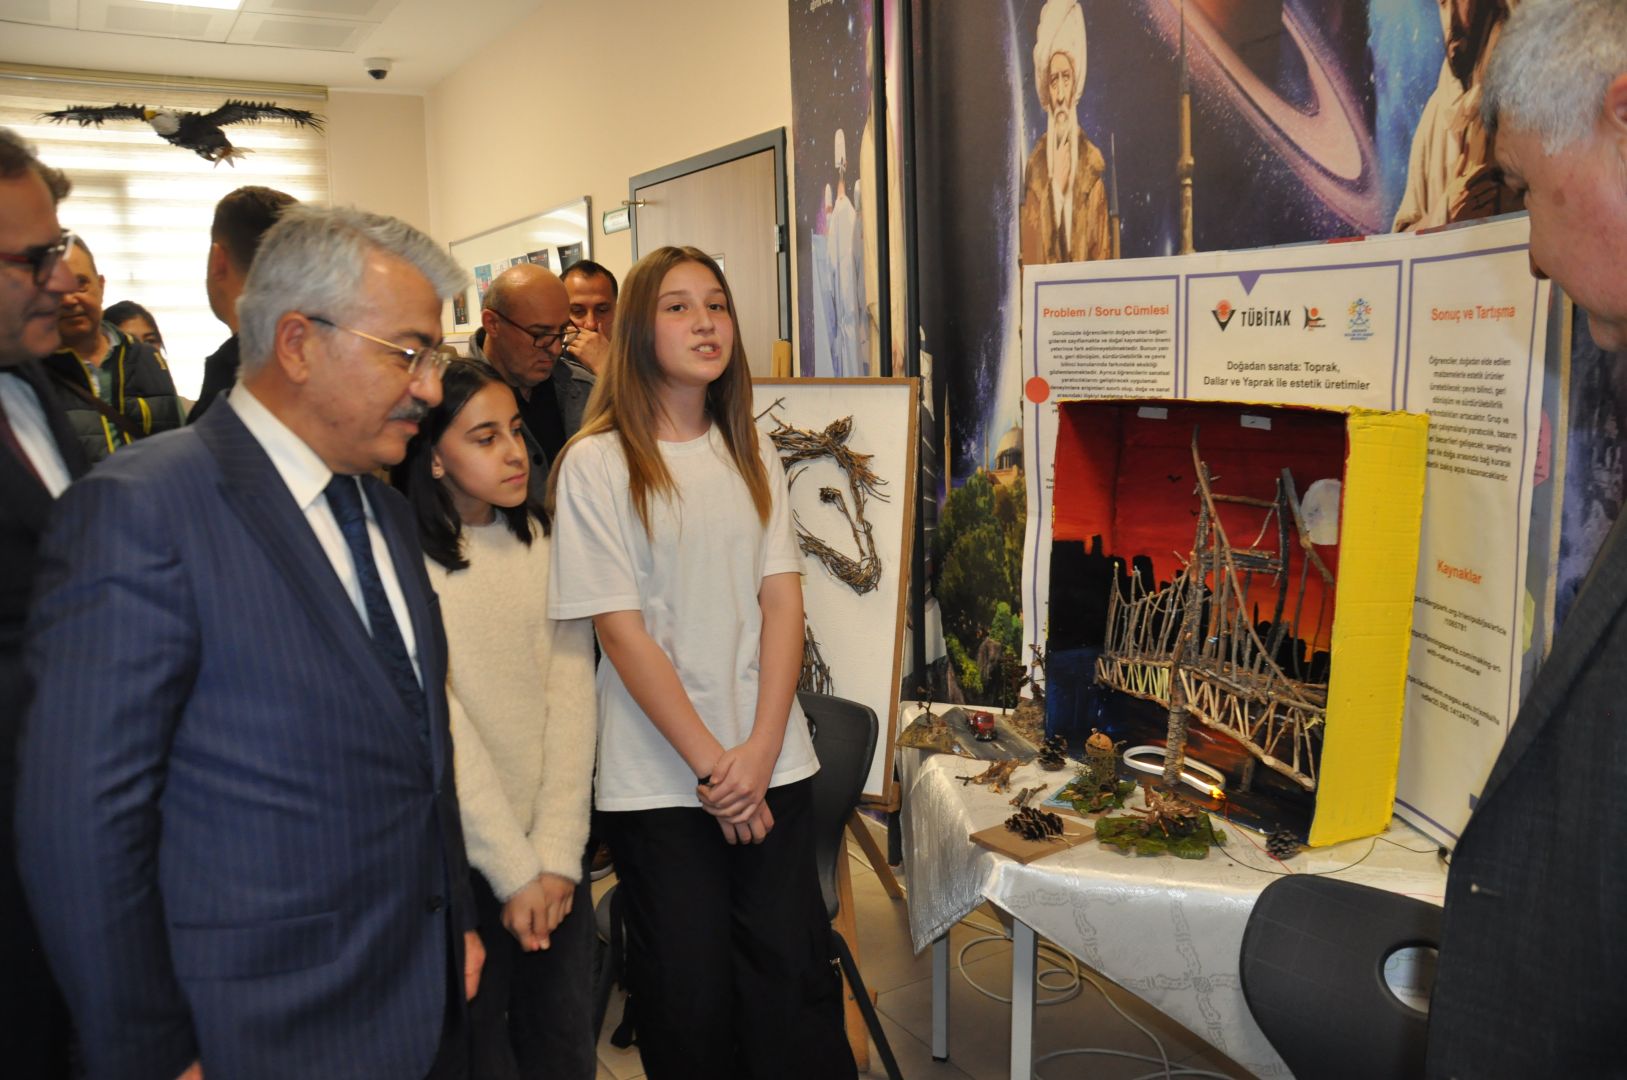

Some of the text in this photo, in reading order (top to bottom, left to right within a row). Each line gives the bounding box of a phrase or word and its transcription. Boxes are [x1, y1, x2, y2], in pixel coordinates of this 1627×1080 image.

[1043, 307, 1086, 318] Problem
[1095, 306, 1121, 317] Soru
[1124, 304, 1169, 316] Cümlesi
[1241, 307, 1291, 327] TÜBİTAK
[1431, 305, 1515, 323] Sonuç ve Tartışma
[1226, 361, 1341, 374] Doğadan sanata: Toprak,
[1203, 376, 1371, 391] Dallar ve Yaprak ile estetik üretimler
[1437, 559, 1482, 585] Kaynaklar
